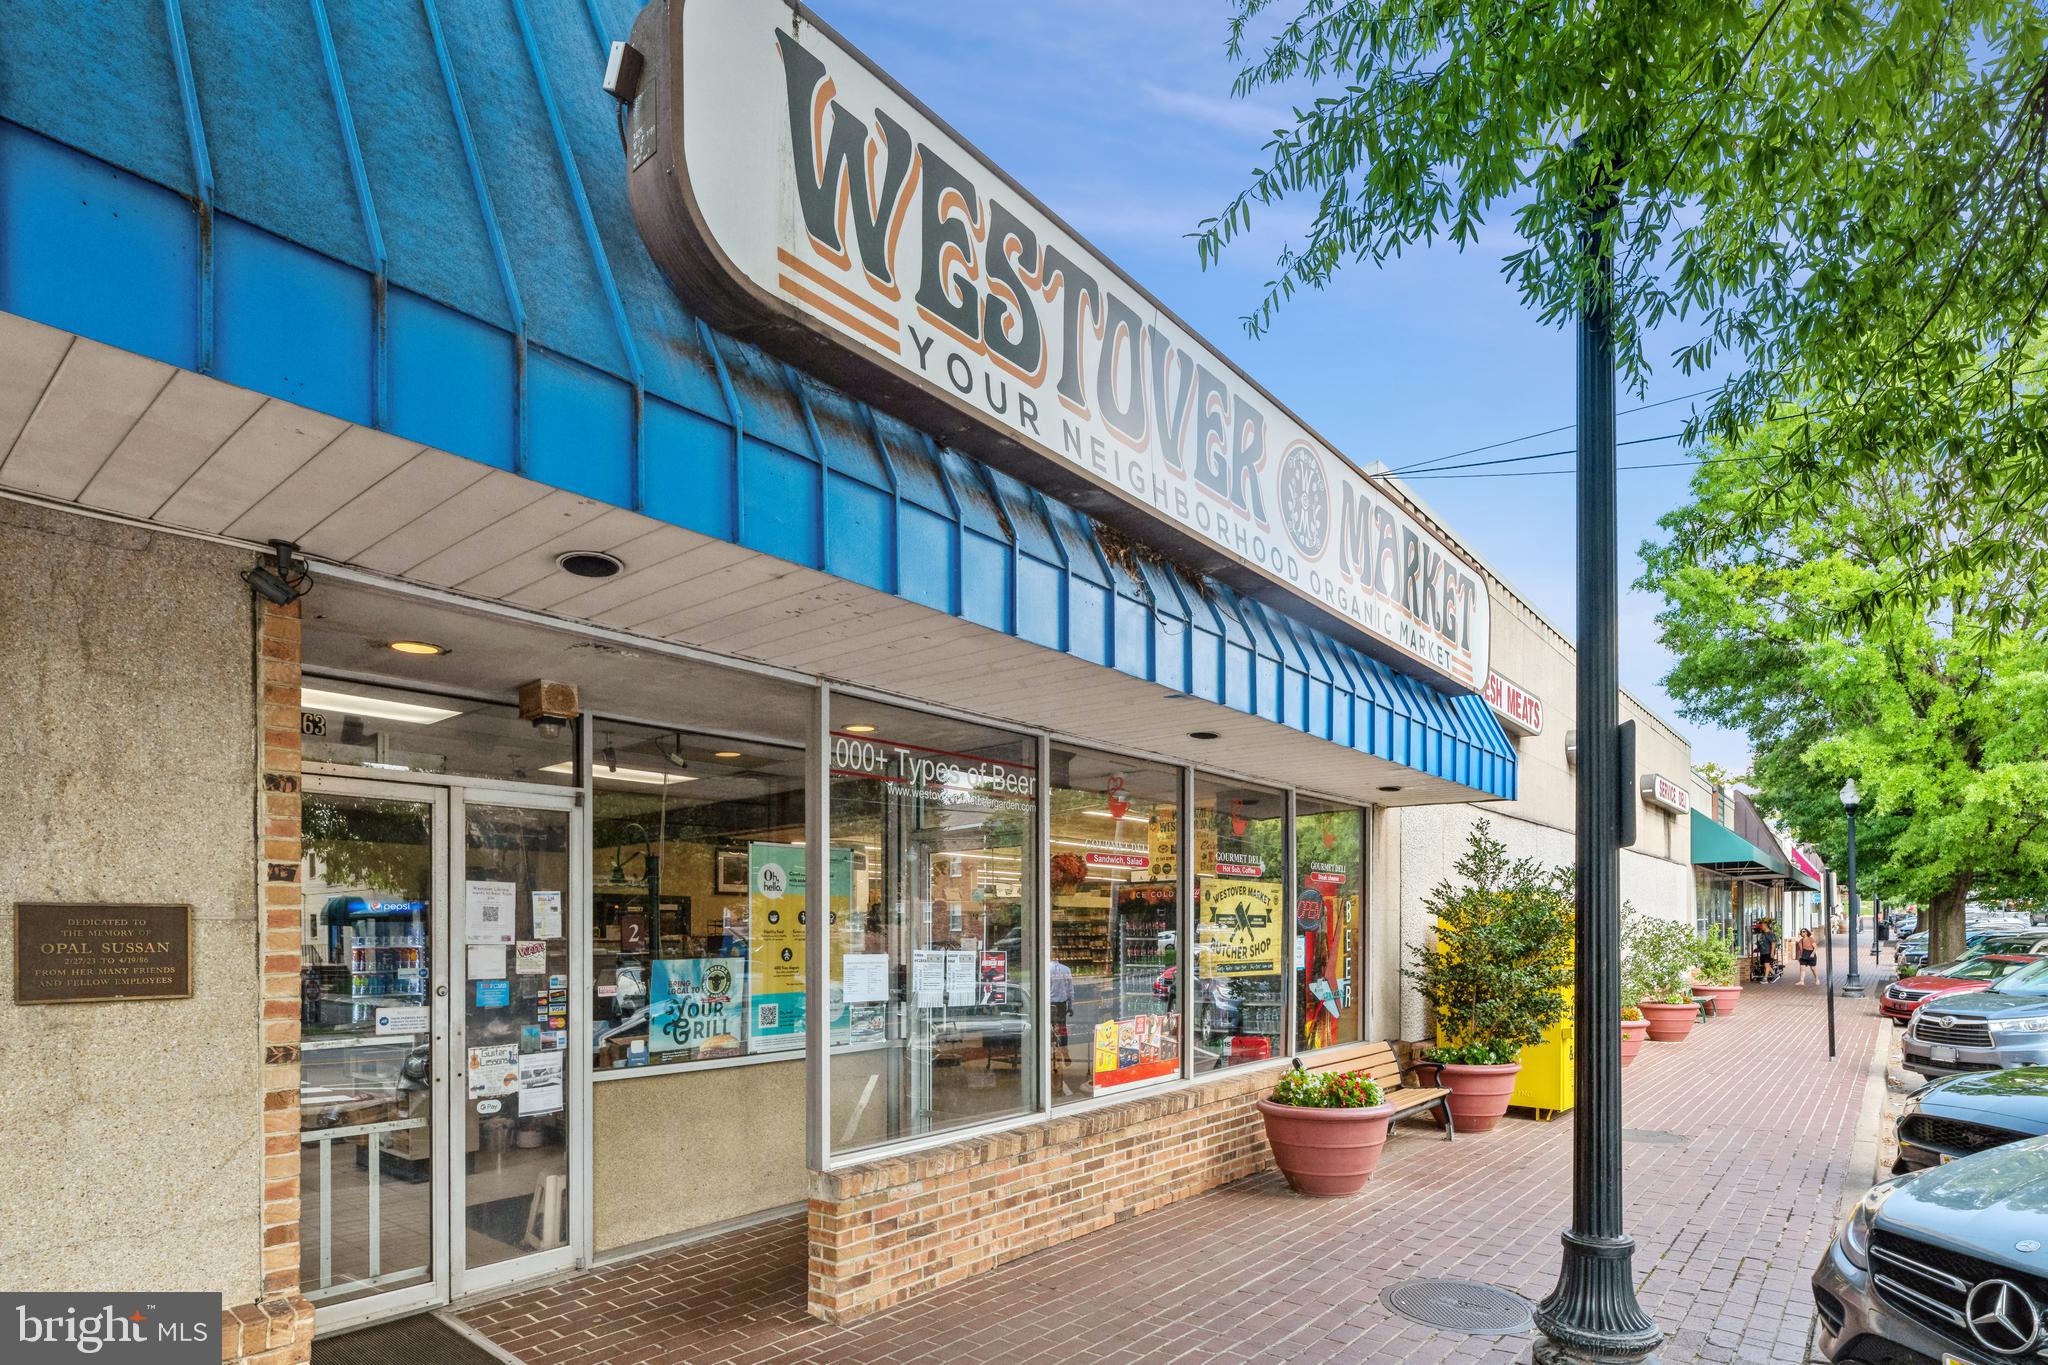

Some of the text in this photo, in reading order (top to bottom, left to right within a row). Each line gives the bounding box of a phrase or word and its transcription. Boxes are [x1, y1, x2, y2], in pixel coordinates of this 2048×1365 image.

[775, 27, 1477, 659] WESTOVER MARKET
[908, 325, 1040, 436] YOUR
[1062, 418, 1299, 581] NEIGHBORHOOD
[1310, 570, 1393, 636] ORGANIC
[1400, 621, 1451, 670] MARKET
[1482, 674, 1540, 730] ESH MEATS
[895, 747, 960, 786] Types
[967, 762, 986, 788] of
[992, 765, 1036, 795] Beer
[1660, 779, 1676, 804] SERVICE
[1093, 854, 1125, 865] Sandwich,
[1126, 856, 1143, 866] Salad
[1215, 851, 1263, 865] GOURMET DELI
[1222, 865, 1231, 873] Hot
[1242, 867, 1256, 875] Coffee
[1310, 861, 1346, 873] GOURMET DELI
[763, 869, 780, 883] Oh,
[763, 882, 783, 892] hello.
[1150, 891, 1174, 899] COLD
[1213, 886, 1247, 904] WESTOVER
[1247, 887, 1271, 906] MARKET
[383, 901, 411, 912] pepsi
[67, 918, 148, 926] DEDICATED TO
[88, 929, 135, 938] MEMORY
[138, 929, 153, 937] OF
[628, 923, 640, 943] 2
[40, 941, 171, 955] OPAL SUSSAN
[1210, 937, 1271, 960] BUTCHER SHOP
[1344, 900, 1352, 1008] BEER
[101, 957, 116, 966] TO
[35, 966, 177, 977] FROM HER MANY FRIENDS
[67, 978, 111, 987] FELLOW
[115, 977, 174, 985] EMPLOYEES
[667, 980, 691, 988] BRING
[667, 987, 689, 995] LOCAL
[664, 995, 724, 1018] YOUR
[662, 1018, 731, 1045] GRILL
